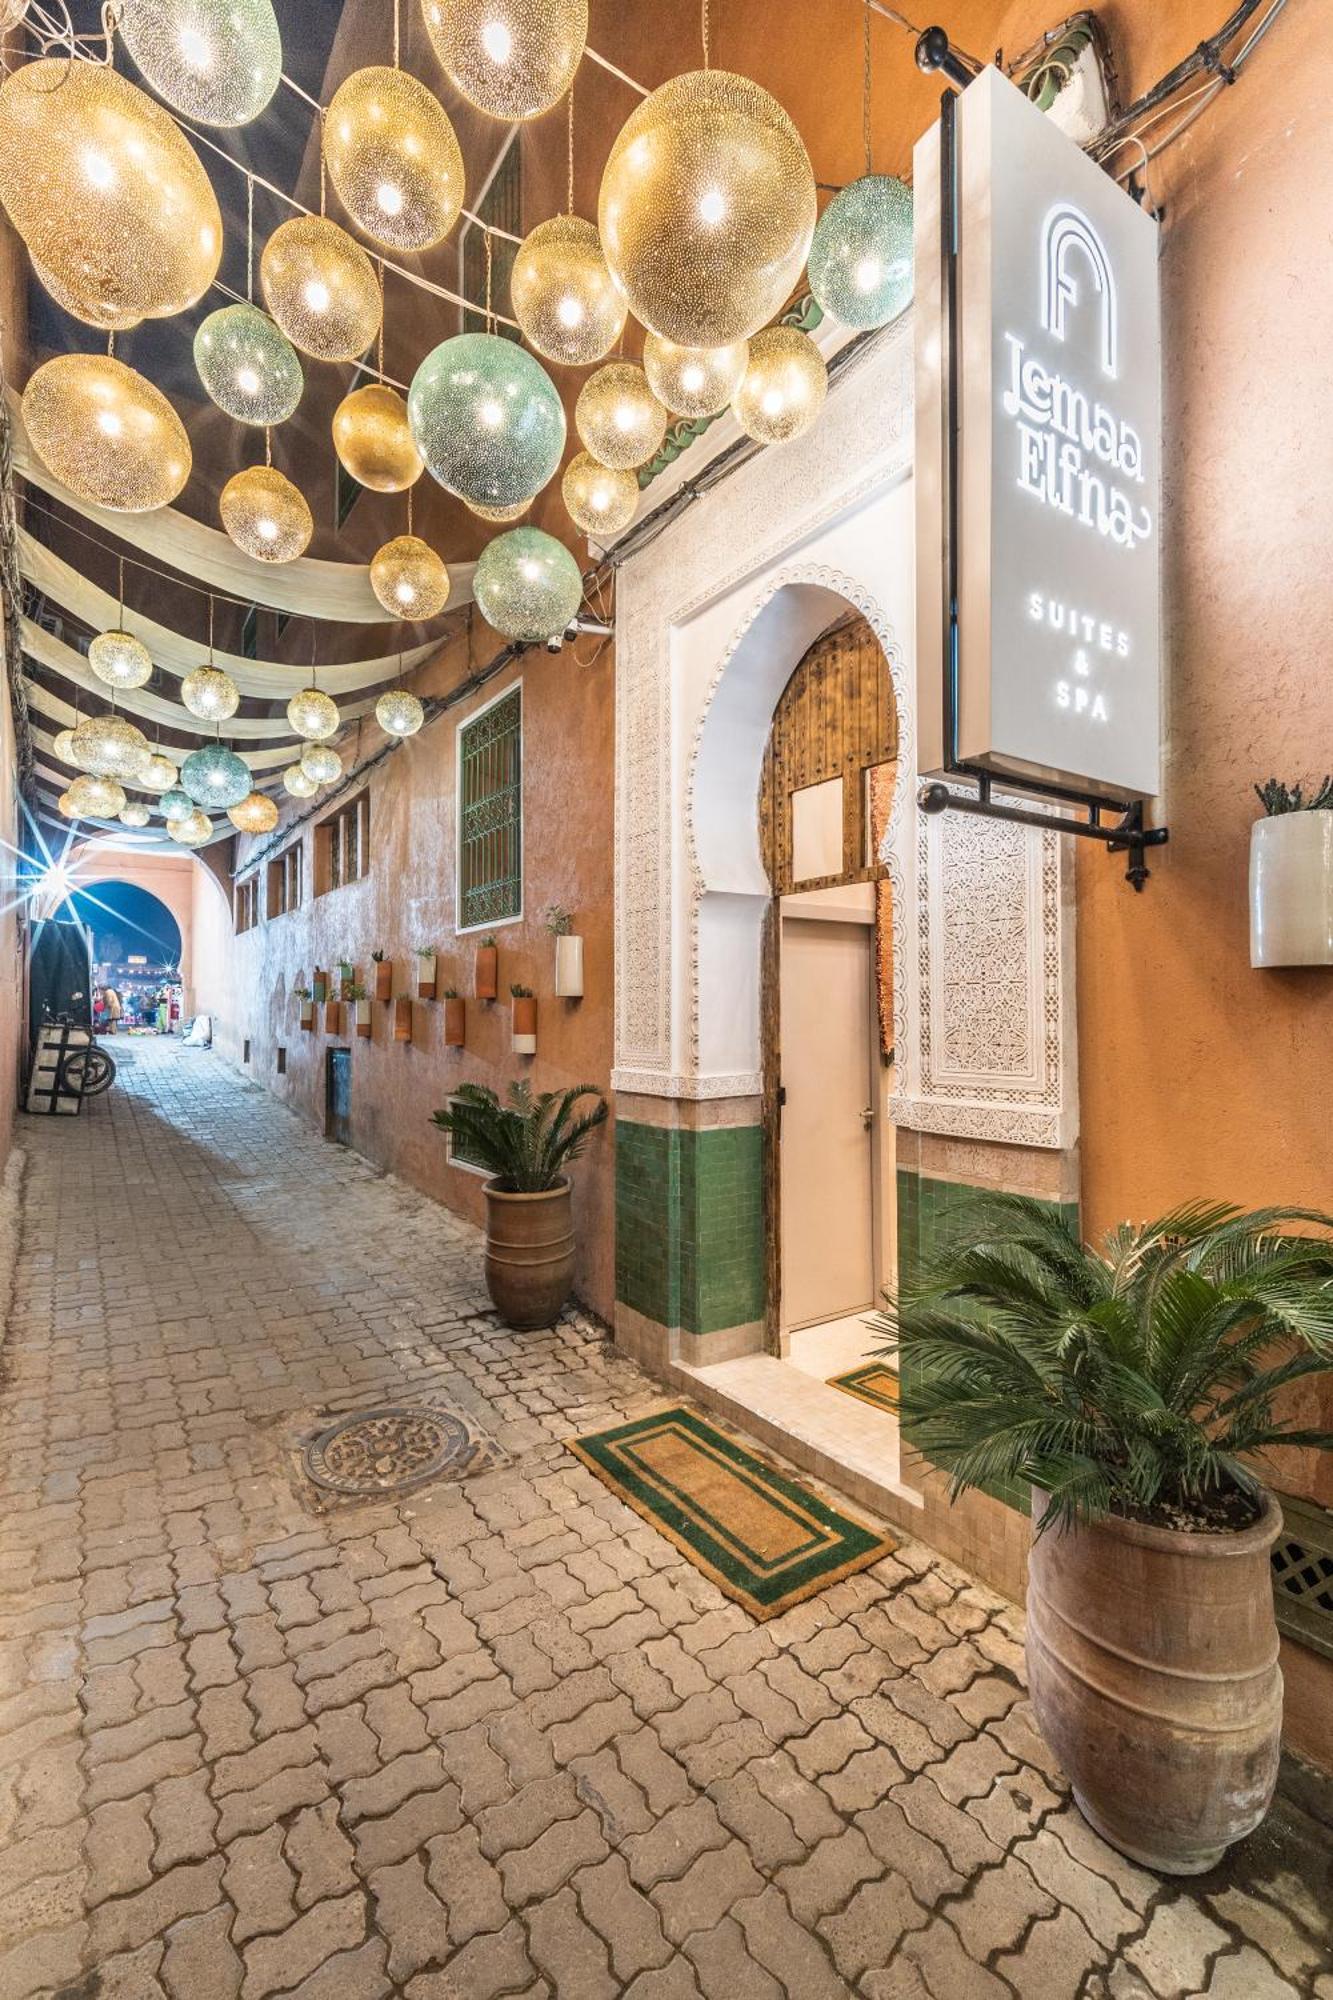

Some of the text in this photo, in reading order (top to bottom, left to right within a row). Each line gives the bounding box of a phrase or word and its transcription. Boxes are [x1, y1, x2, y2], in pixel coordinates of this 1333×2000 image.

[1016, 419, 1152, 549] Elfna
[1028, 592, 1130, 657] SUITES
[1074, 649, 1090, 676] &
[1056, 680, 1108, 722] SPA
